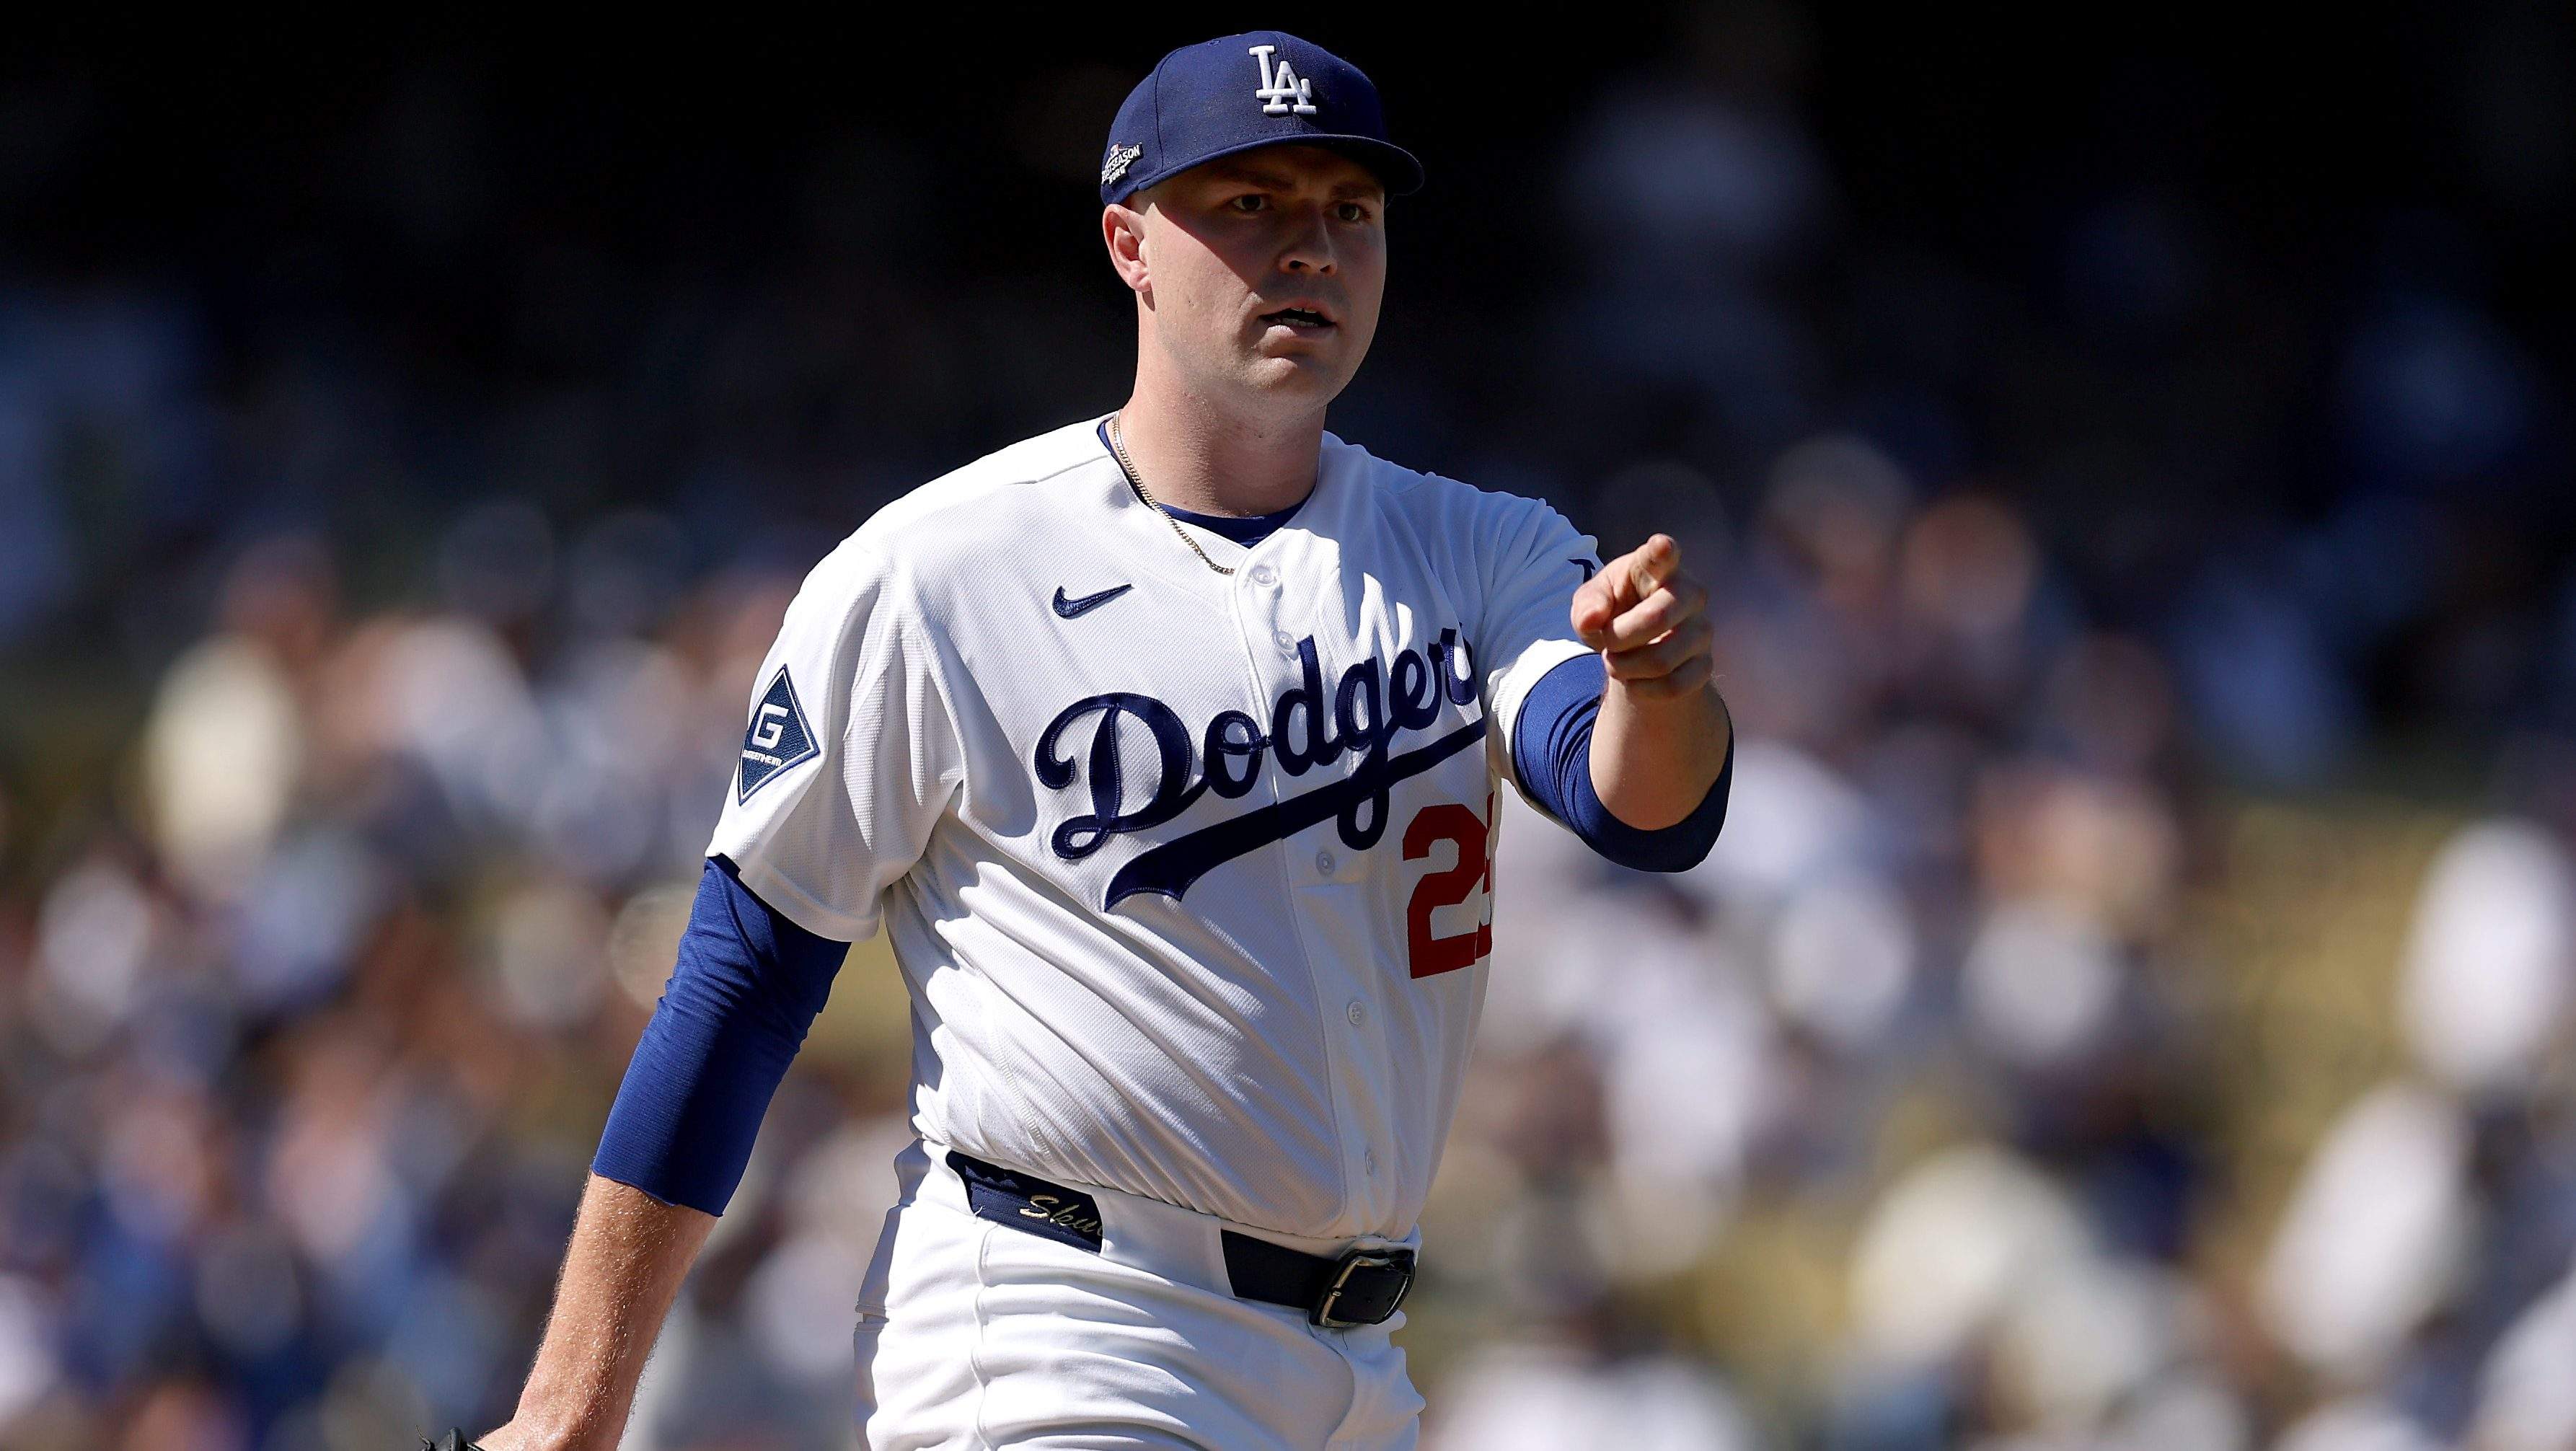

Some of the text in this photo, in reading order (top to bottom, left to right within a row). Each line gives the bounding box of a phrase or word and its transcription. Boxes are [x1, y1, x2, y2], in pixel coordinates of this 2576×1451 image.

[1248, 45, 1317, 114] LA
[751, 702, 789, 749] G
[1403, 791, 1494, 979] 2
[1019, 1194, 1103, 1236] Sku
